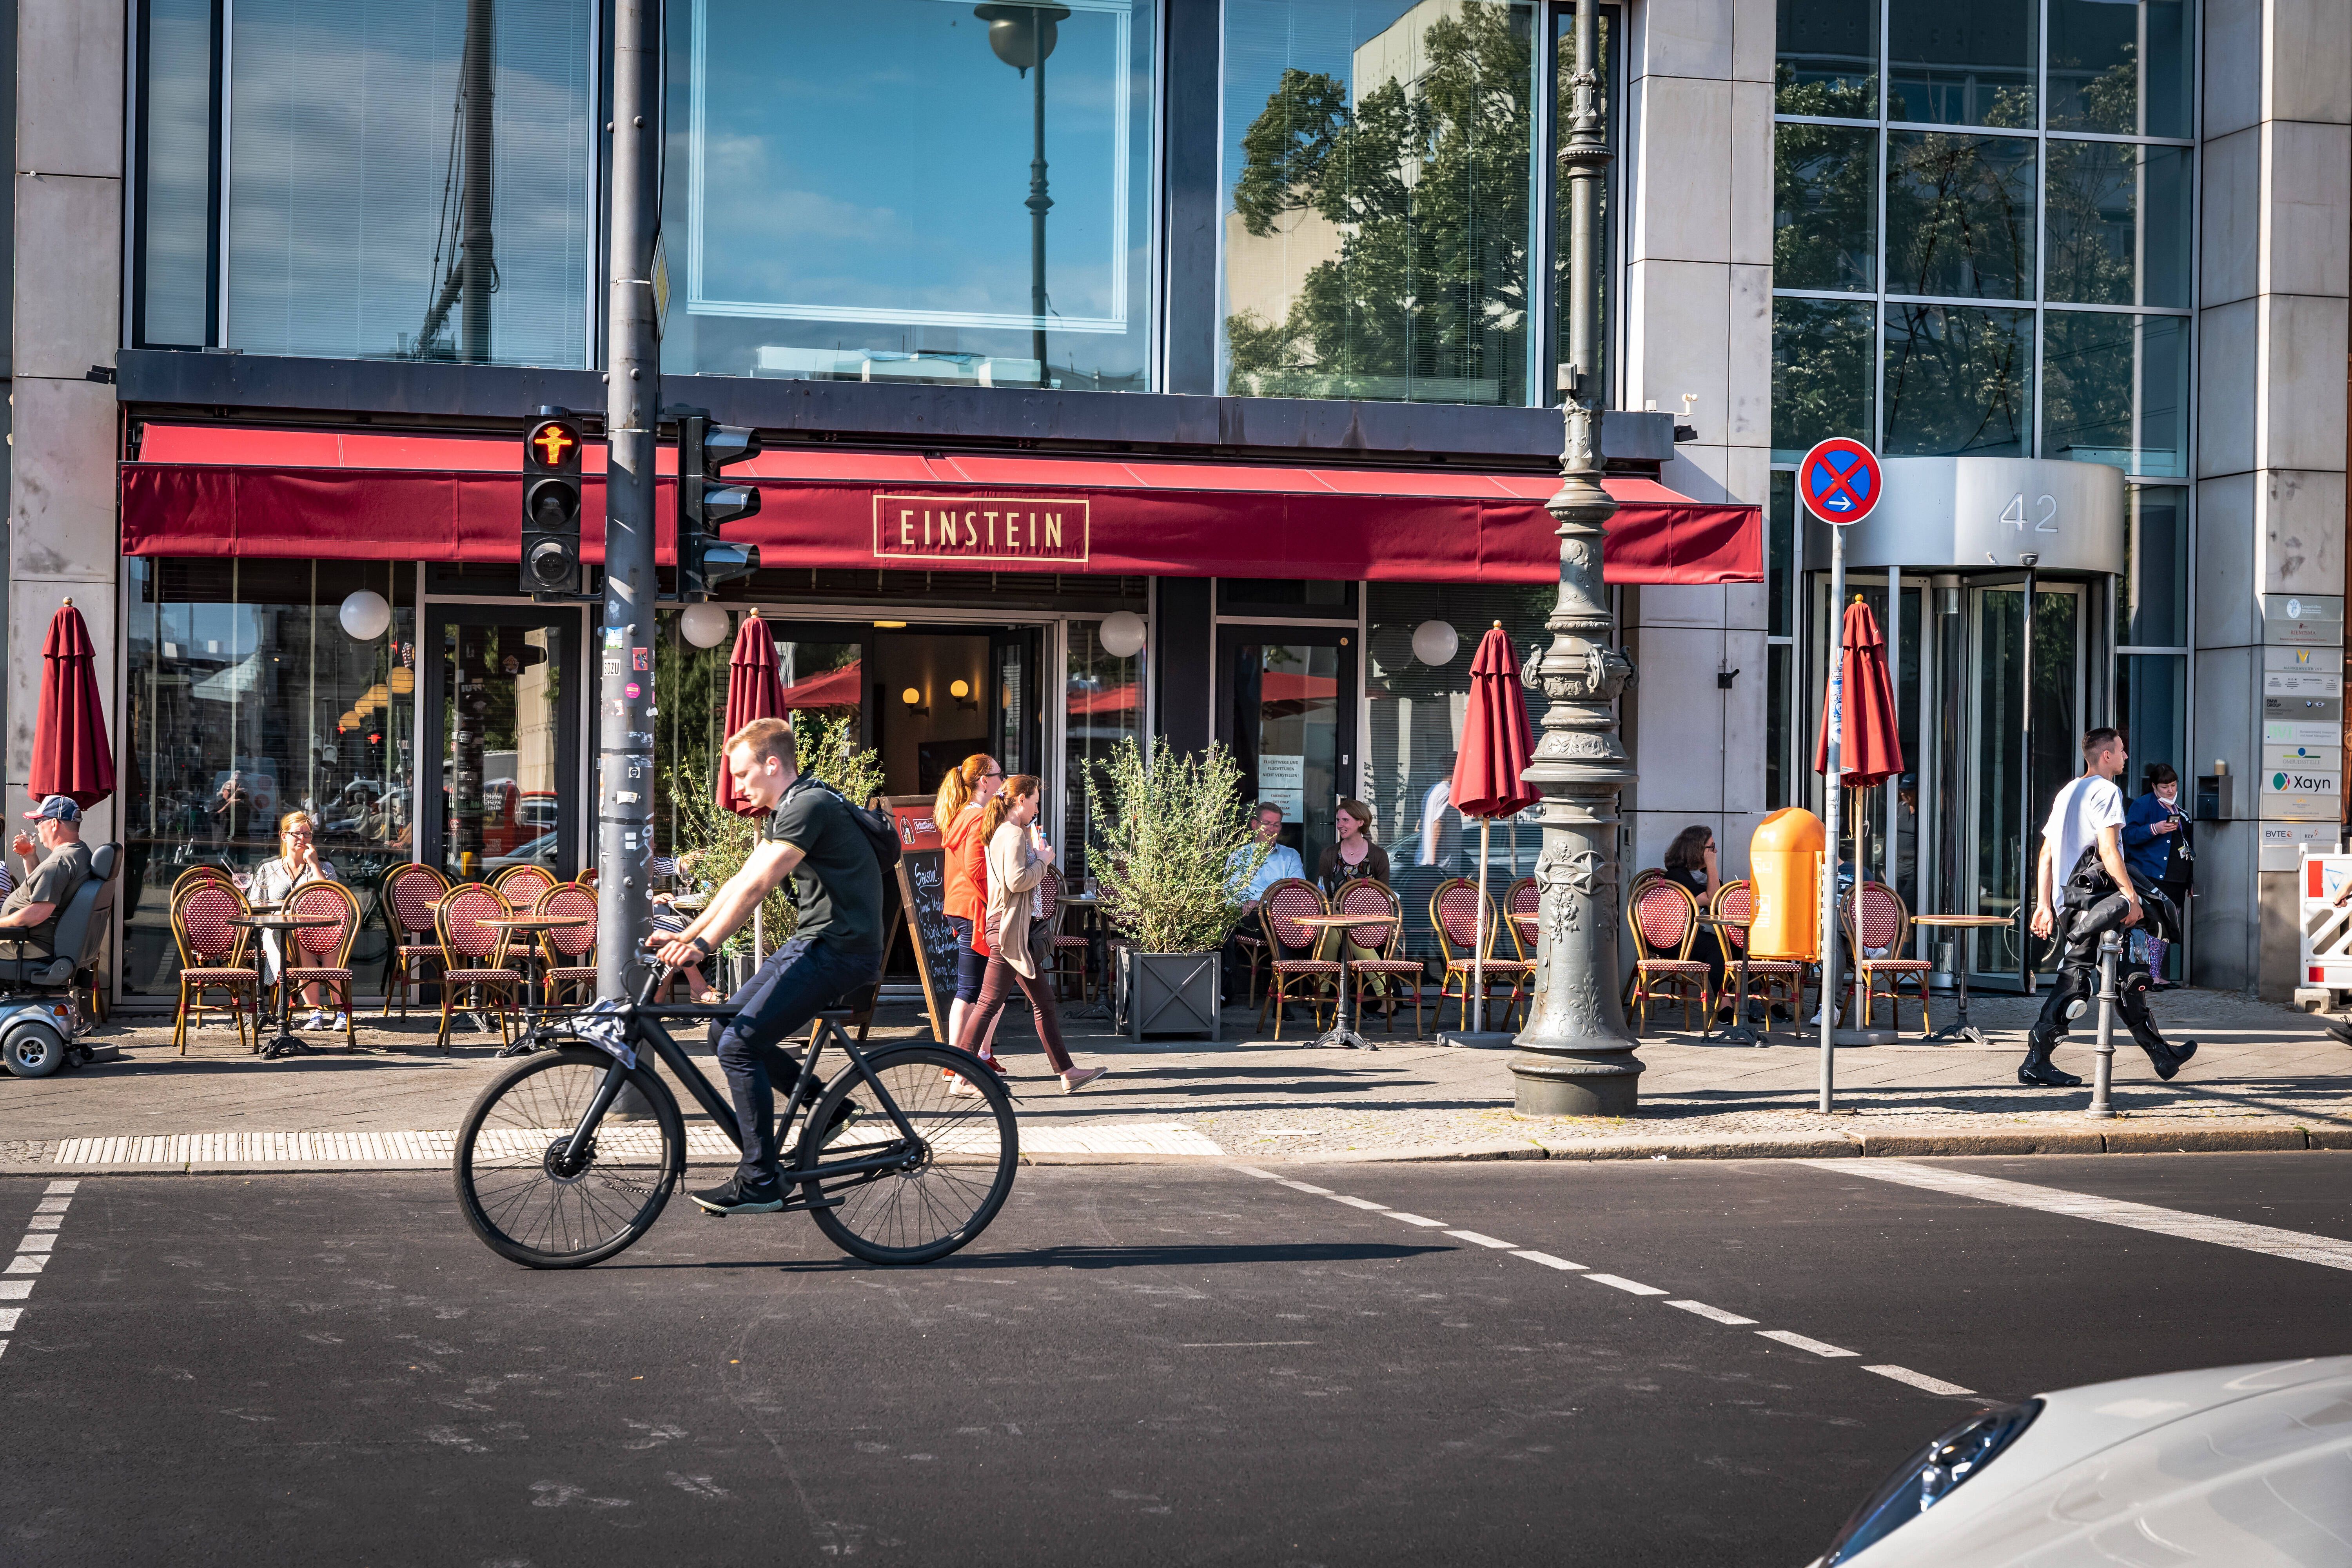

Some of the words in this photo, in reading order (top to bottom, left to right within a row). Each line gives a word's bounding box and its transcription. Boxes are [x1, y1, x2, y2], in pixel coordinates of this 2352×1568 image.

[1998, 492, 2059, 533] 42
[901, 510, 1061, 547] EINSTEIN
[605, 662, 619, 674] SOZU
[2294, 776, 2330, 792] Xayn
[915, 820, 934, 830] Schultheiss
[915, 857, 940, 886] Saison!
